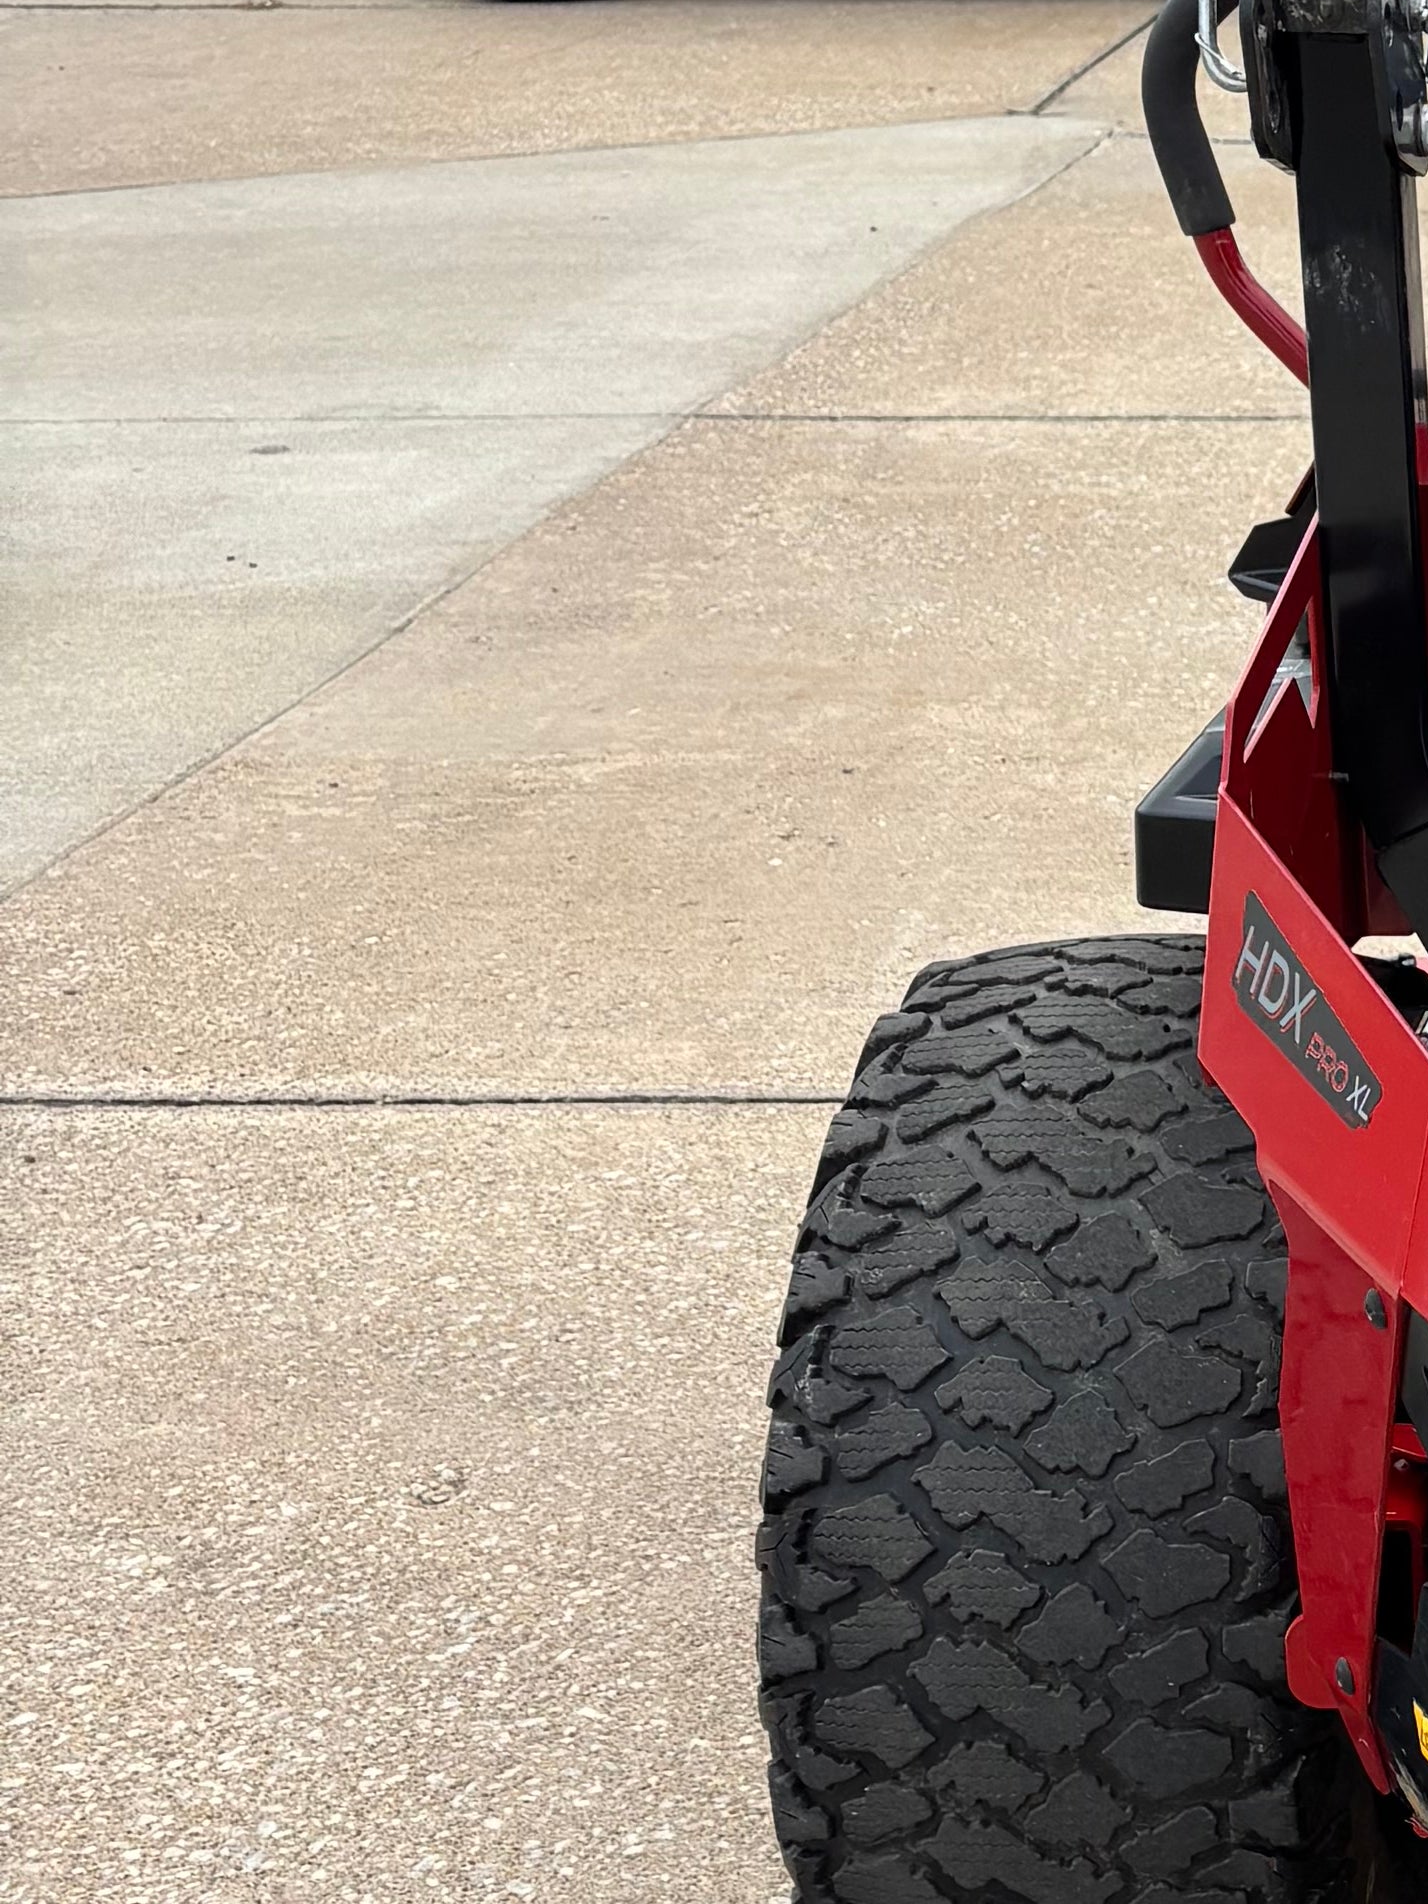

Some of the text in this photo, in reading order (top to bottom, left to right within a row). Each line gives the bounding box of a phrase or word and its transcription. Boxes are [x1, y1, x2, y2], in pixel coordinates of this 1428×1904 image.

[1235, 925, 1372, 1121] HDX PRO XL
